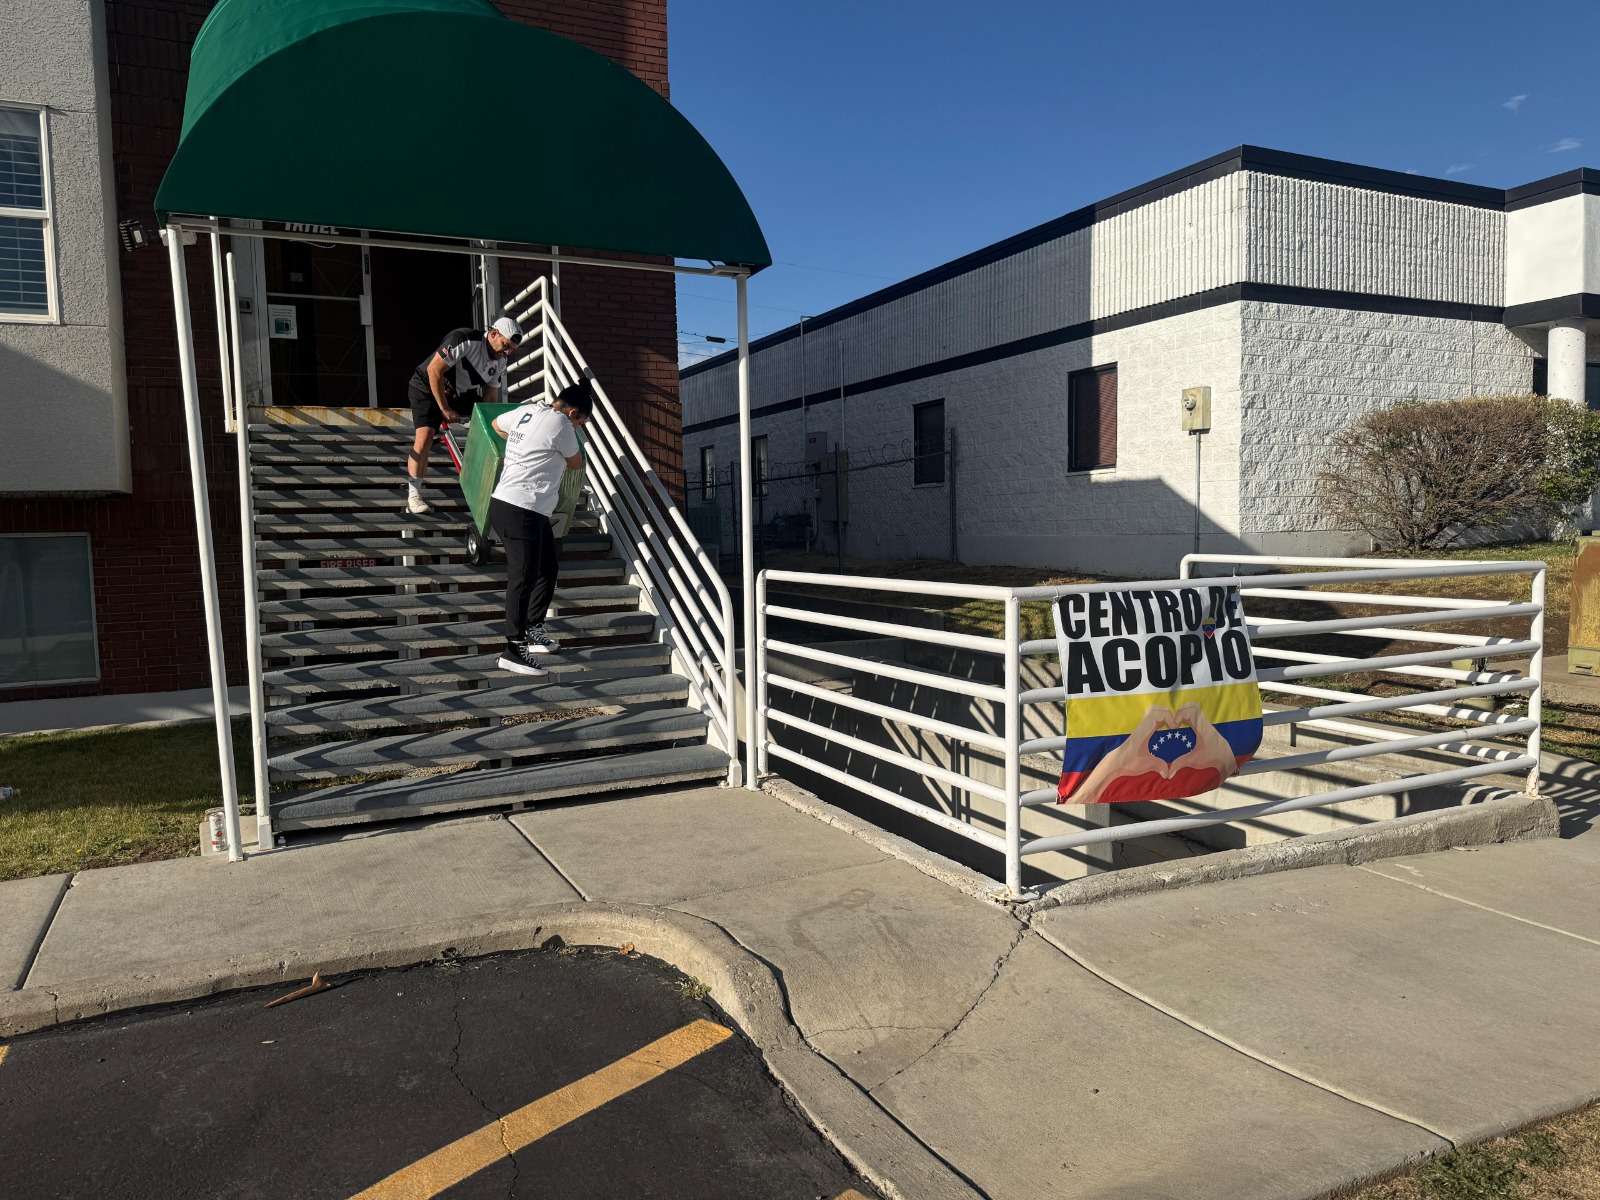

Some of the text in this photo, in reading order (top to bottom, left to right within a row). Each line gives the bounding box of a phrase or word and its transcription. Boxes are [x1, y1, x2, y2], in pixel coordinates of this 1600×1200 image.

[320, 559, 376, 568] FIRE RISER
[1058, 585, 1243, 640] CENTRO DE
[1067, 630, 1252, 695] ACOPIO
